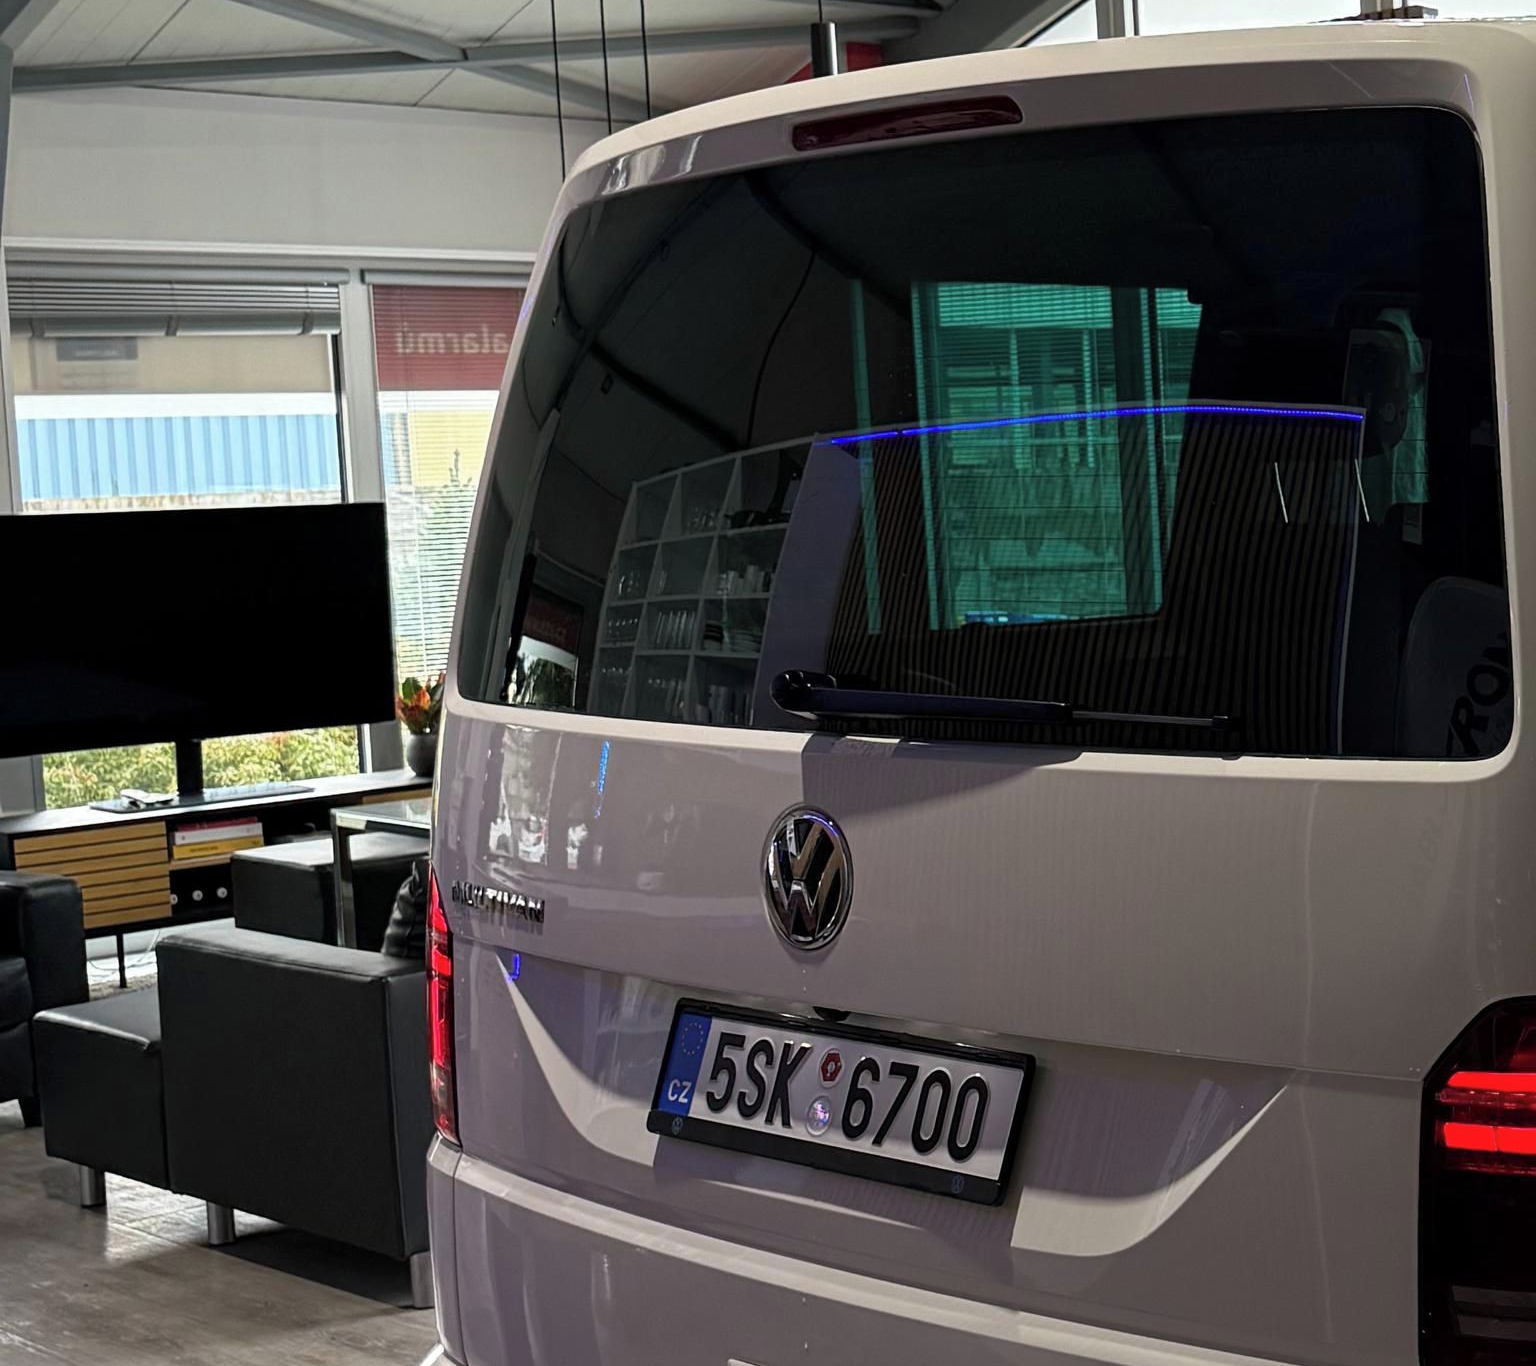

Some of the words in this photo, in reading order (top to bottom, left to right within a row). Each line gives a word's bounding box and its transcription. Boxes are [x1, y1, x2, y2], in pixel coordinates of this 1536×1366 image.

[667, 1078, 692, 1104] CZ
[705, 1031, 814, 1129] 5SK
[841, 1056, 990, 1163] 6700
